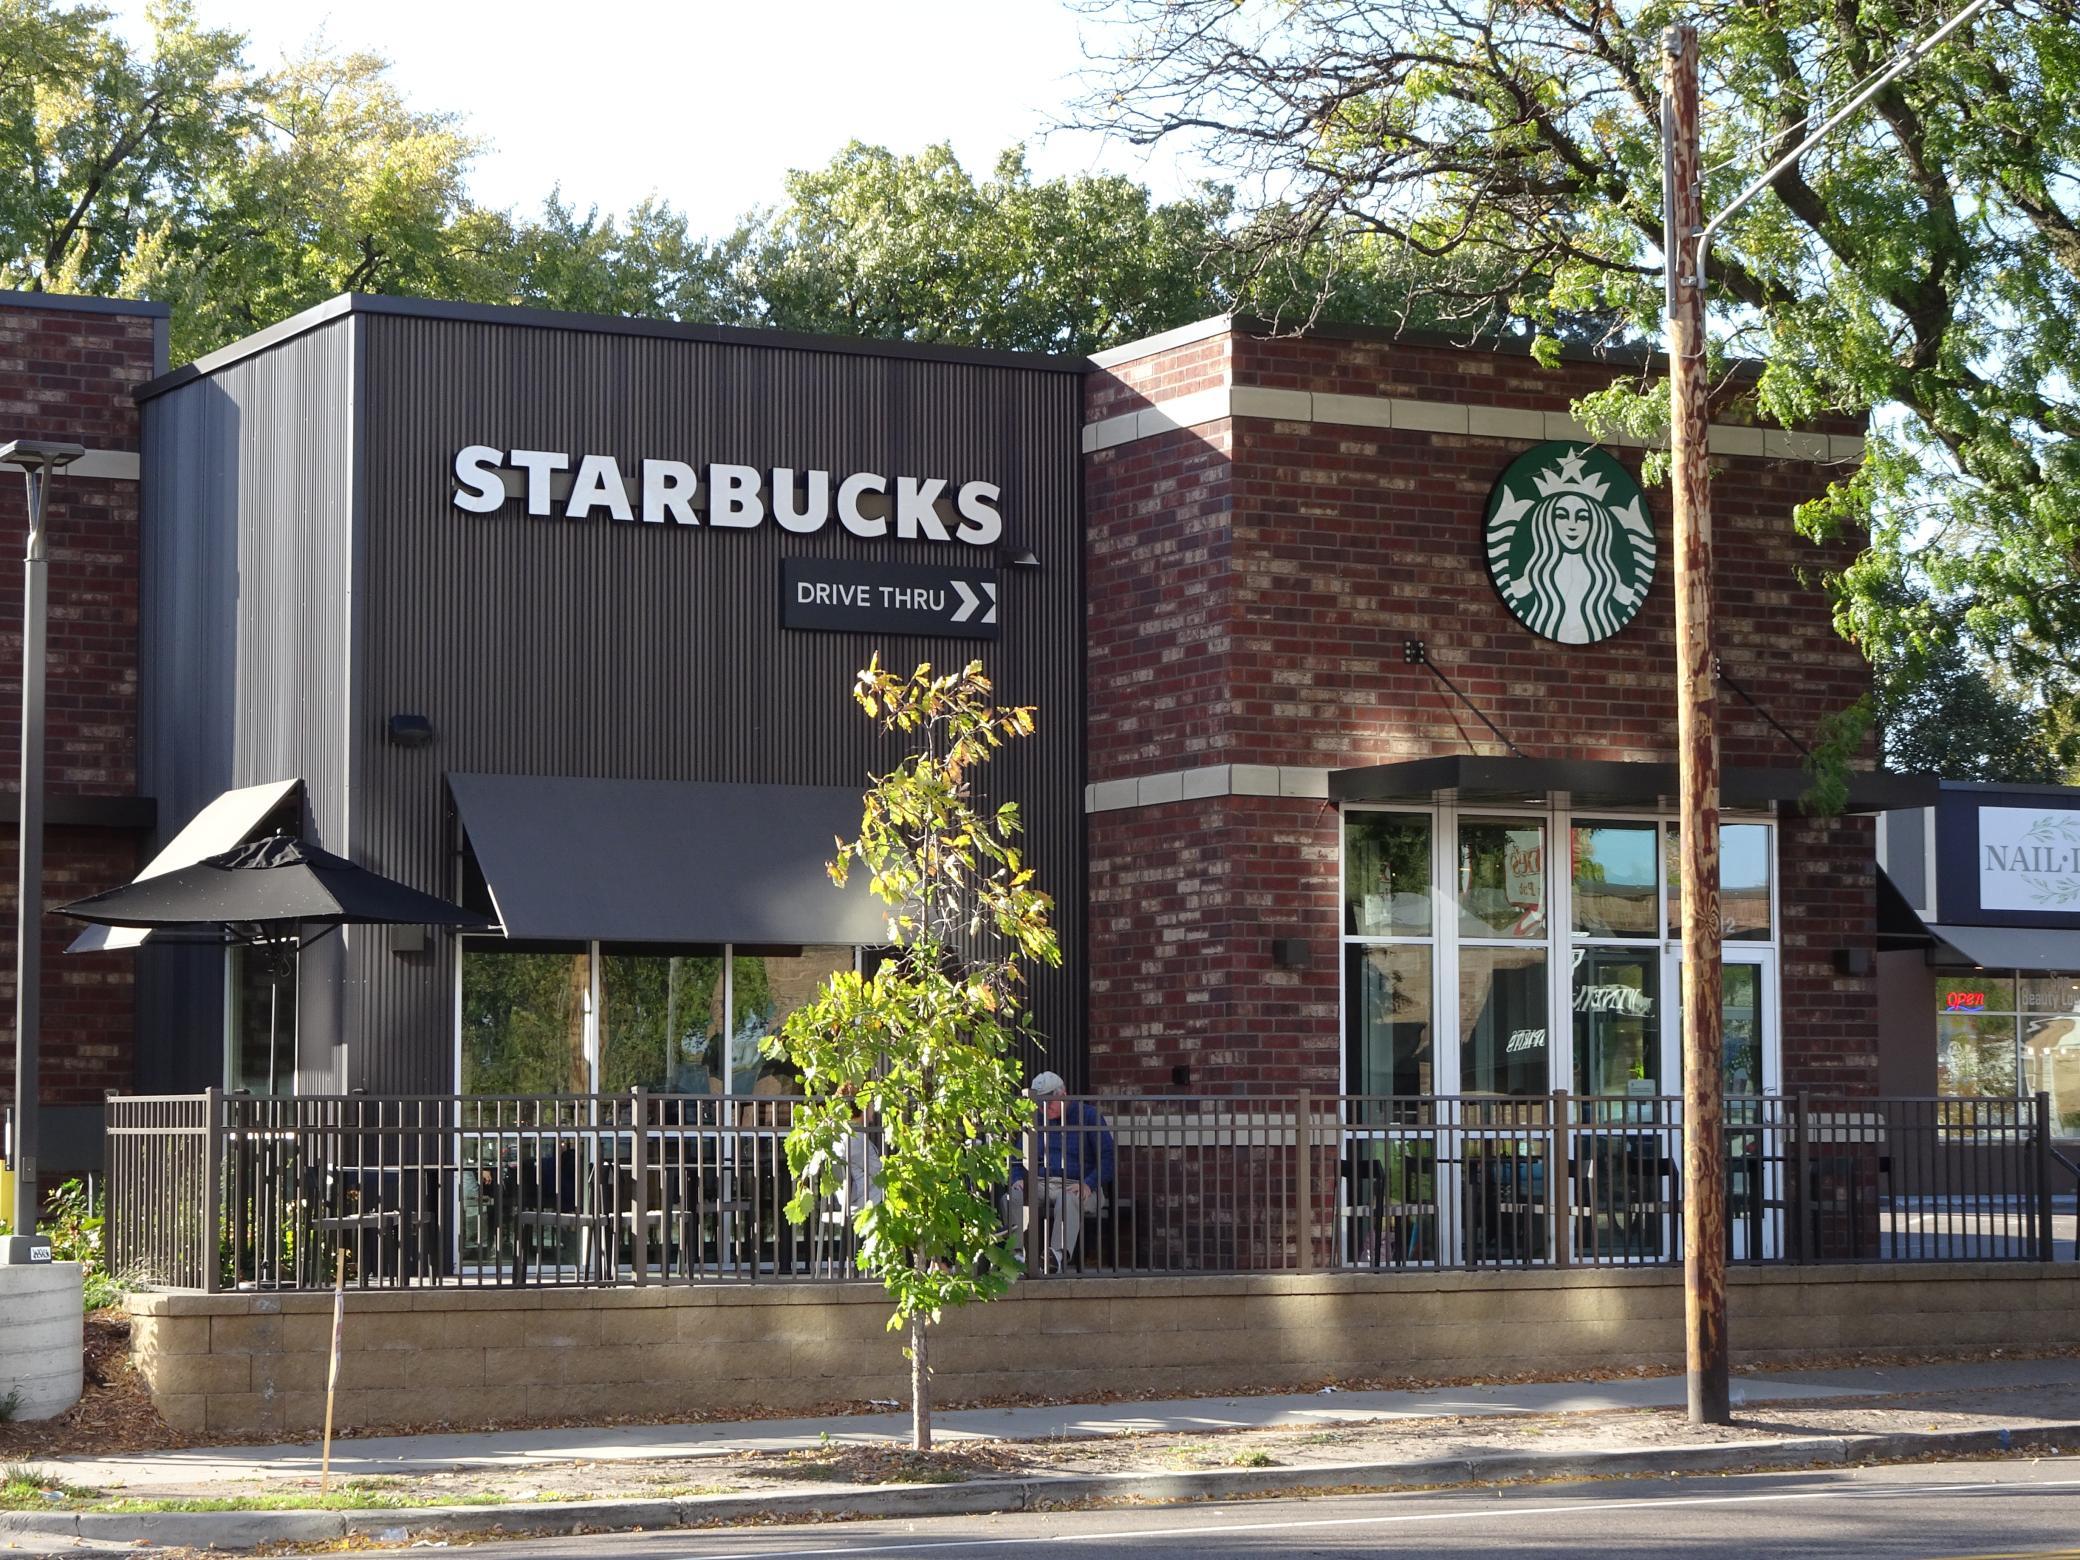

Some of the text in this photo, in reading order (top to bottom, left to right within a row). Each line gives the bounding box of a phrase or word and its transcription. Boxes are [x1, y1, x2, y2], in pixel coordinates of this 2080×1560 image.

[453, 445, 1002, 545] STARBUCKS
[797, 582, 945, 611] DRIVE THRU
